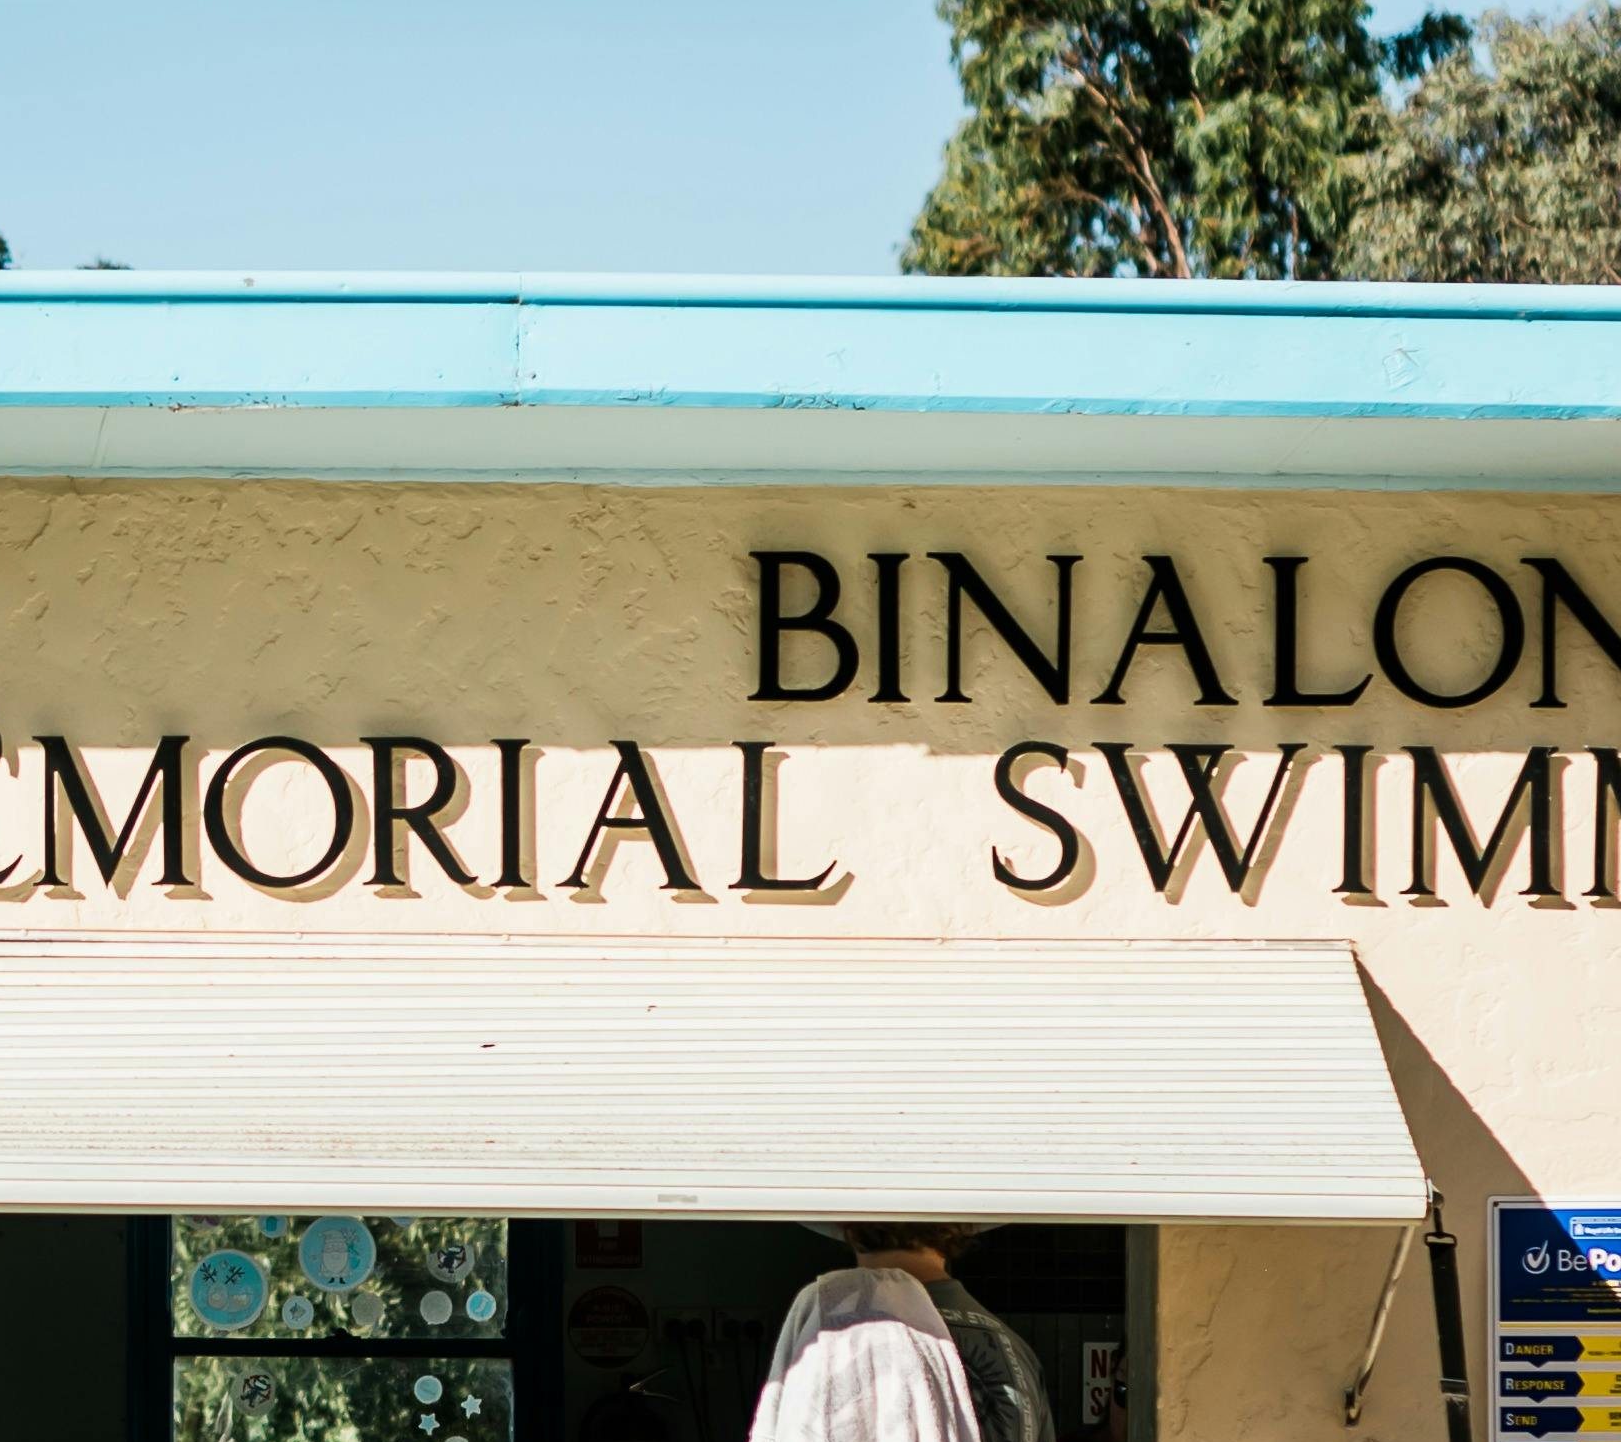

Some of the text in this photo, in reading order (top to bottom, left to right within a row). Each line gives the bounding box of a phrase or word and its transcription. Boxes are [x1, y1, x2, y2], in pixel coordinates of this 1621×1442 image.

[1505, 1343, 1554, 1356] DANGER
[1505, 1379, 1566, 1391] RESPONSE
[1505, 1414, 1538, 1426] SEND
